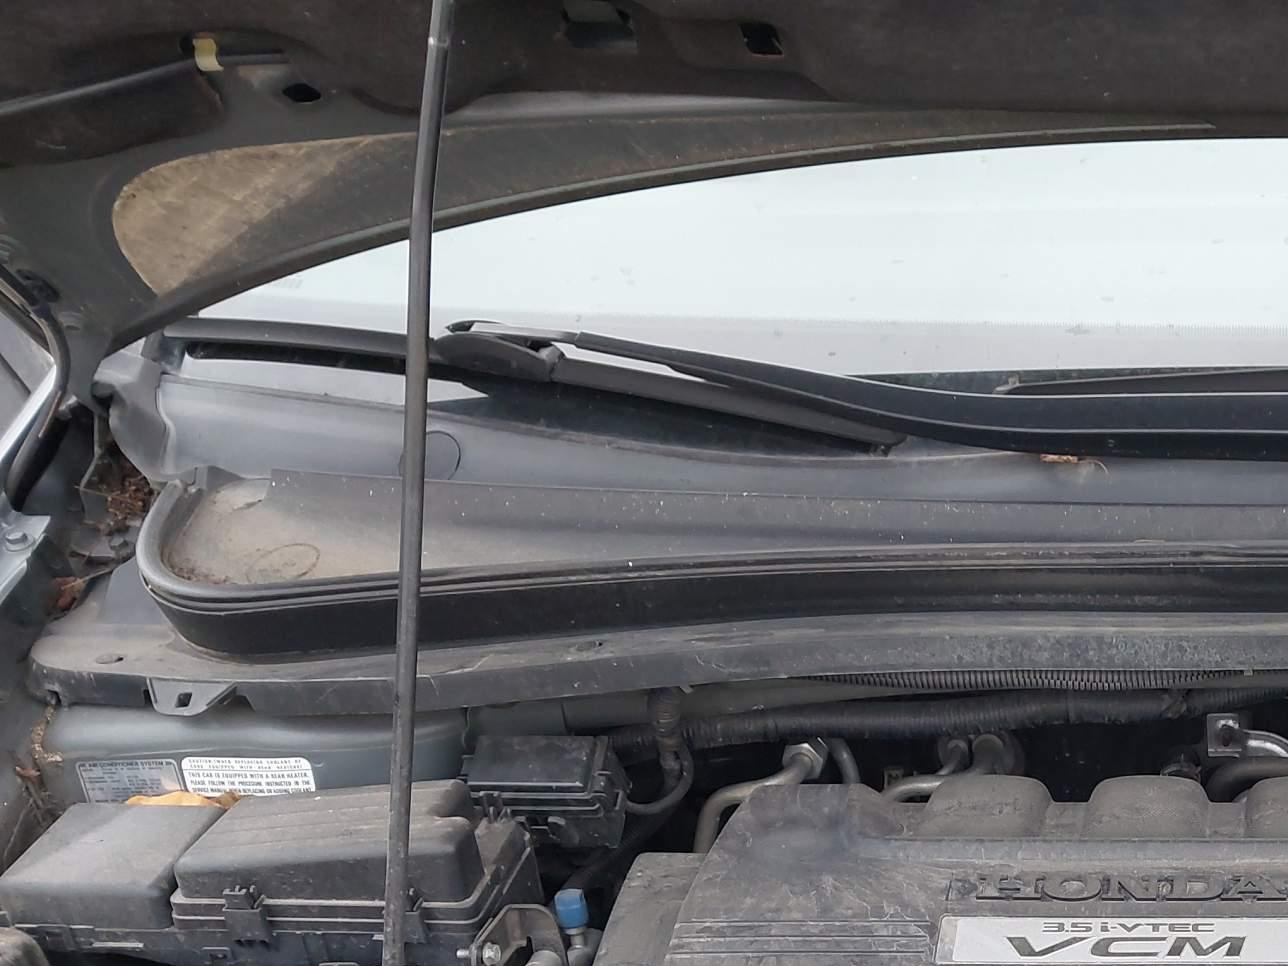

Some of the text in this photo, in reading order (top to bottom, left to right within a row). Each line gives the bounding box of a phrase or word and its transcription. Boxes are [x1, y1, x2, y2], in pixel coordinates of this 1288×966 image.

[976, 874, 1288, 901] HONDA
[1042, 922, 1215, 933] 3.5 i-VTEC
[1006, 936, 1247, 958] VCM
